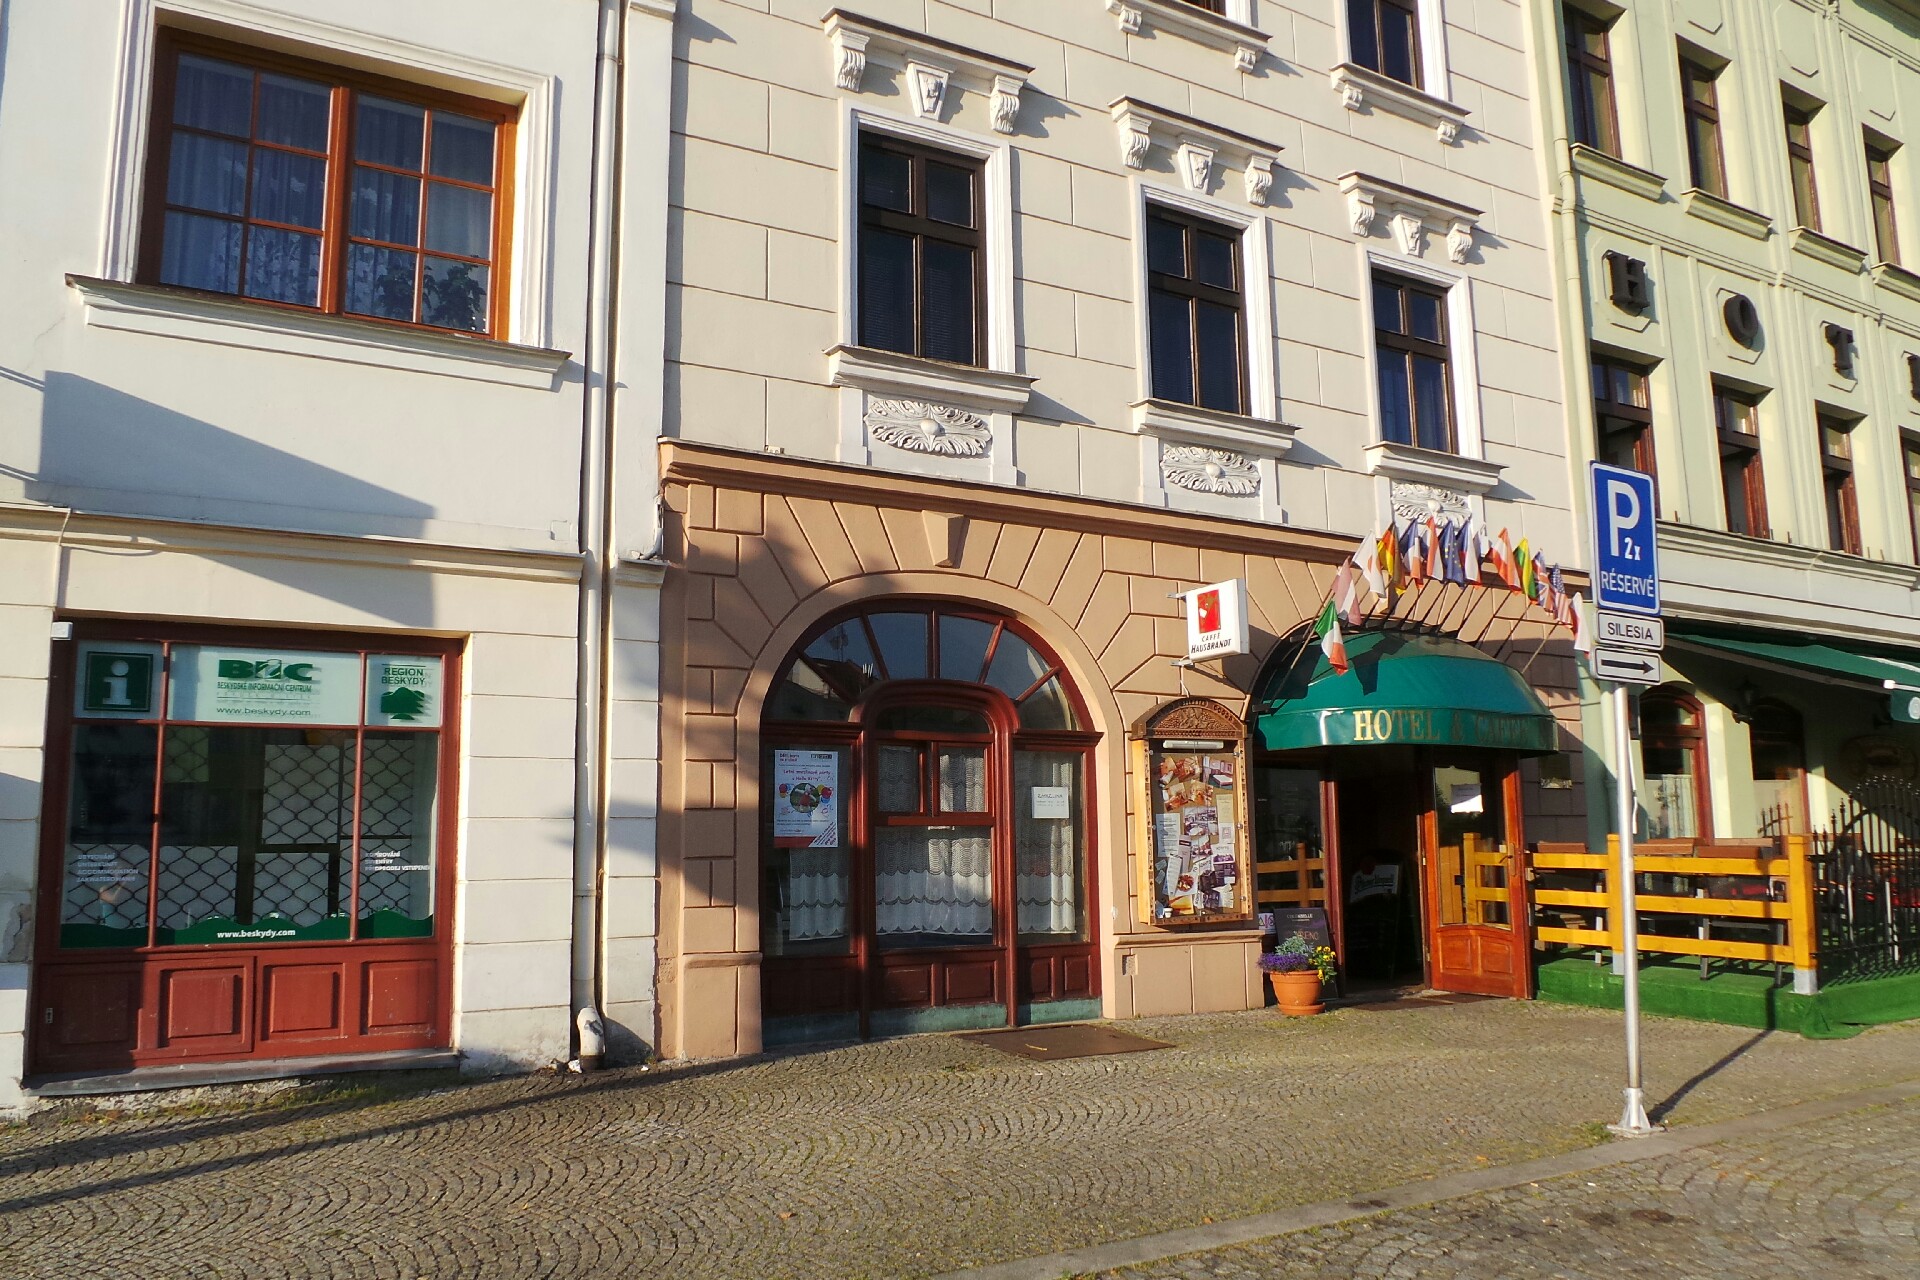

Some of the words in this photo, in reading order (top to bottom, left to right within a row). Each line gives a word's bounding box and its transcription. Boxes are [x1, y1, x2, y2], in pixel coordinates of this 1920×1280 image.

[1607, 479, 1640, 557] P
[1624, 537, 1641, 561] 2x
[1601, 567, 1655, 598] RÉSERVÉ
[1607, 621, 1654, 641] SILESIA
[1191, 638, 1232, 654] HAUSBRANDT
[384, 667, 424, 676] REGION
[285, 684, 312, 692] CENTRUM
[381, 676, 426, 686] BESKYDY
[216, 707, 311, 717] www.beskydy.com
[1353, 709, 1440, 742] HOTEL
[216, 928, 297, 939] www.beskydy.com
